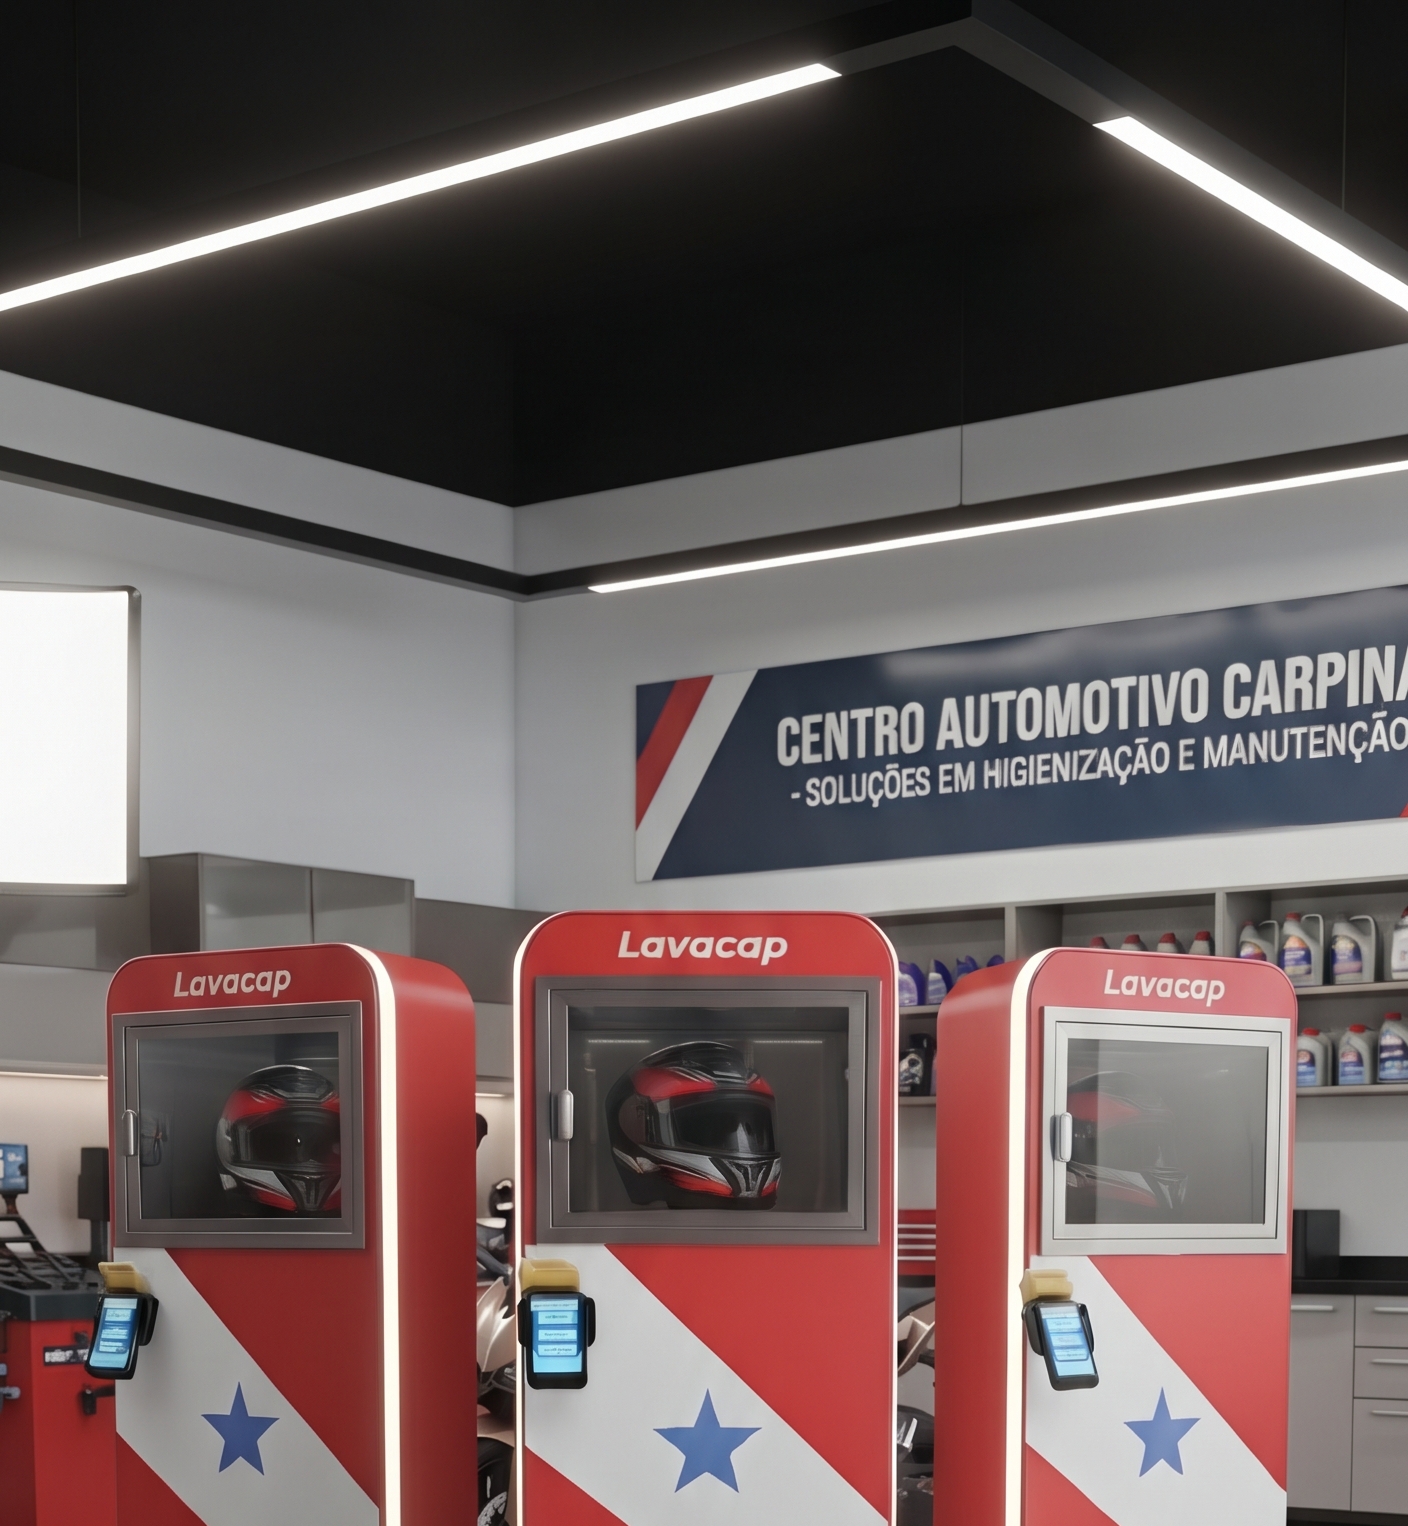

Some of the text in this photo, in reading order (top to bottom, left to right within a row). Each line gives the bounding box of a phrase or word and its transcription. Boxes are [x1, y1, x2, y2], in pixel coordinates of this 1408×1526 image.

[777, 701, 925, 767] CENTRO
[936, 668, 1209, 751] AUTOMOTIVO
[806, 763, 931, 808] SOLUÇÕES
[939, 761, 975, 794] EM
[984, 737, 1170, 786] HIGIENIZAÇÃO
[1179, 738, 1196, 771] E
[1203, 711, 1408, 764] MANUTENÇÃO
[618, 931, 788, 965] Lavacap
[174, 969, 292, 998] Lavacap
[1103, 969, 1226, 1007] Lavacap
